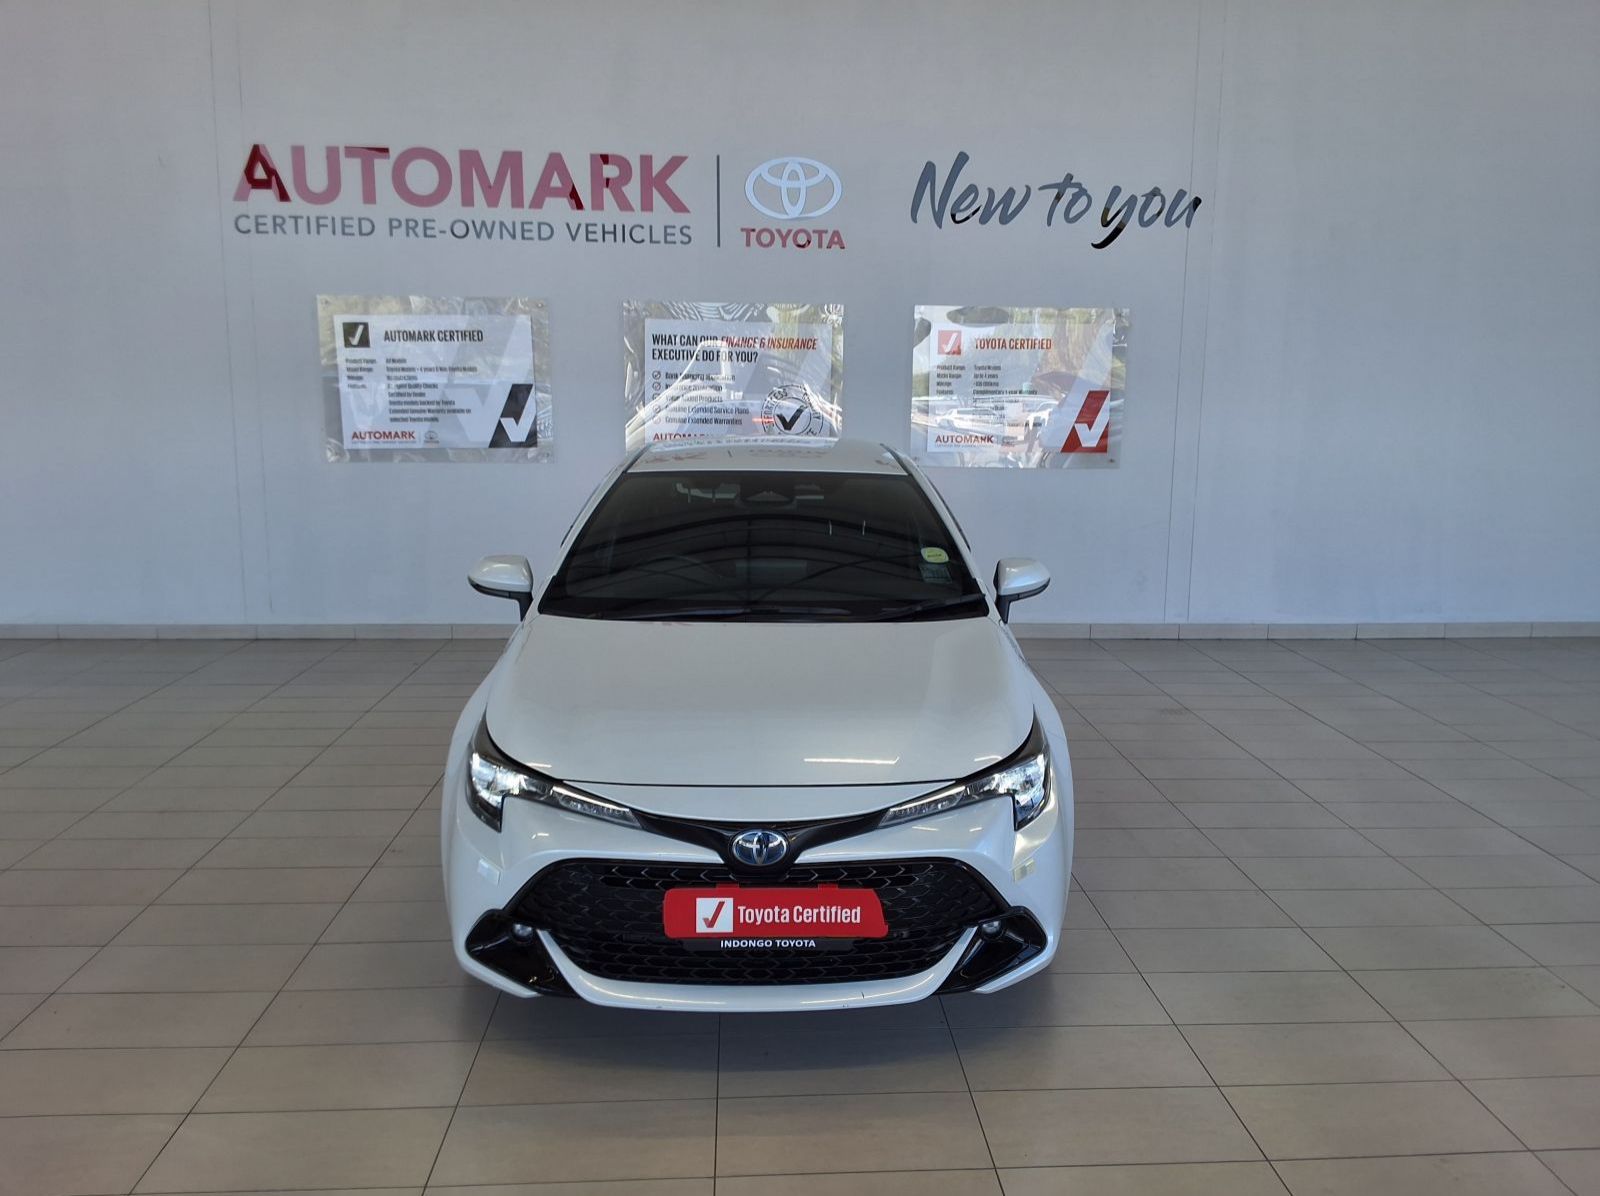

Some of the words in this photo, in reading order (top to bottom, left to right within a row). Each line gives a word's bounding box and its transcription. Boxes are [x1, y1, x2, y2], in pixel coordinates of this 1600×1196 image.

[232, 144, 692, 214] AUTOMARK
[910, 151, 1031, 229] New
[1038, 173, 1092, 227] to
[1091, 185, 1202, 250] you
[234, 214, 375, 237] CERTIFIED
[388, 218, 555, 241] PRE-OWNED
[566, 223, 692, 246] VEHICLES
[740, 227, 846, 250] TOYOTA
[384, 330, 435, 342] AUTOMARK
[437, 330, 484, 342] CERTIFIED
[652, 334, 679, 346] WHAT
[679, 334, 698, 347] CAN
[700, 335, 719, 347] OUR
[720, 336, 758, 349] FINANCE
[759, 337, 766, 349] &
[767, 337, 817, 350] INSURANCE
[975, 338, 1007, 350] TOYOTA
[1008, 338, 1052, 350] CERTIFIED
[652, 349, 701, 362] EXECUTIVE
[702, 350, 714, 362] DO
[716, 350, 733, 362] FOR
[734, 351, 758, 363] YOU?
[352, 431, 416, 441] AUTOMARK
[935, 435, 994, 444] AUTOMARK
[737, 905, 790, 926] Toyota
[793, 905, 861, 924] Certified
[720, 939, 773, 948] INDONGO
[774, 939, 816, 948] TOYOTA
